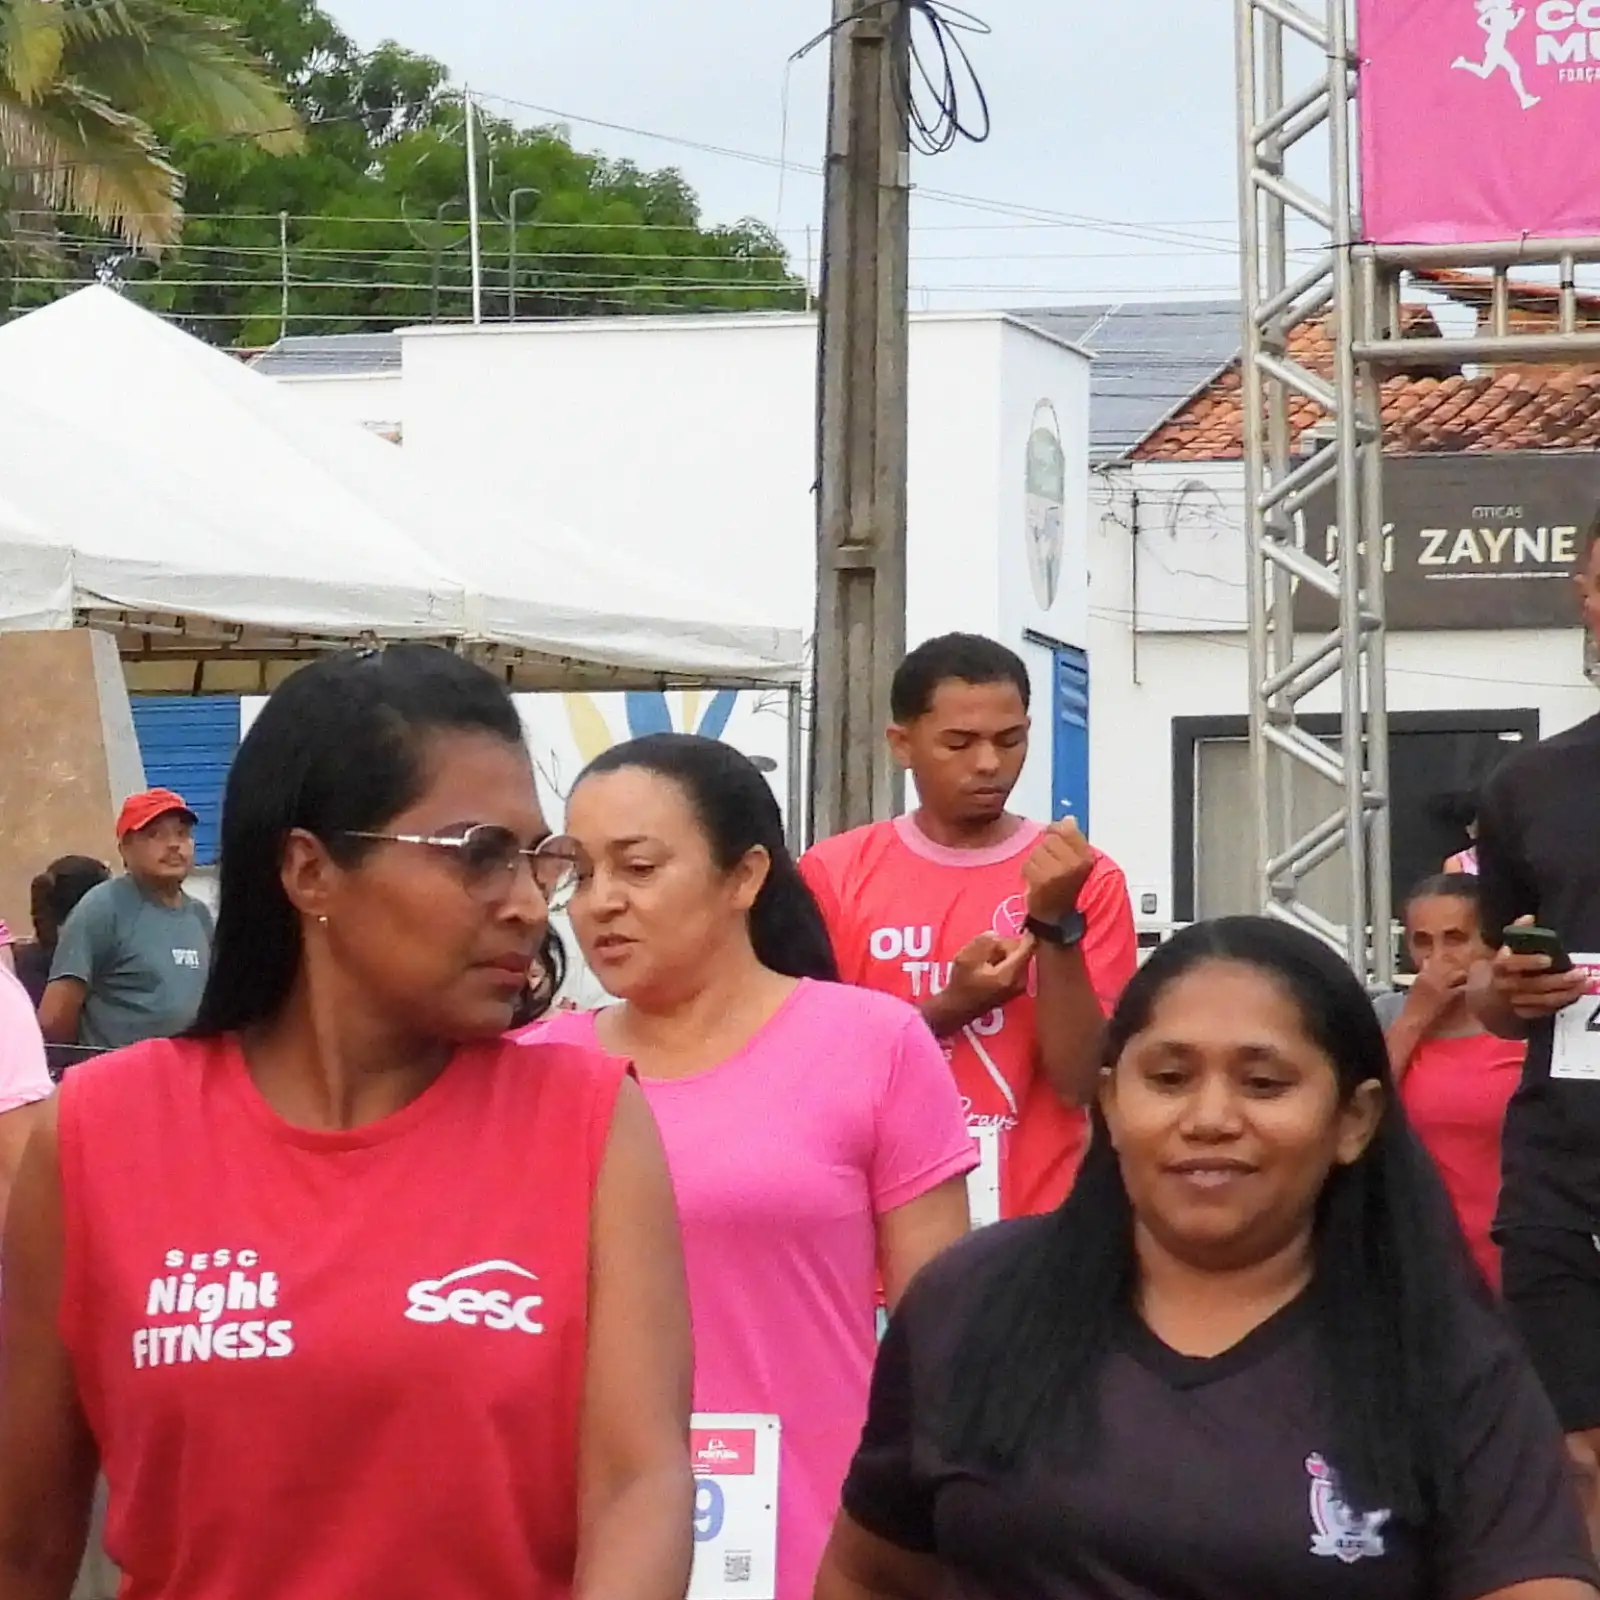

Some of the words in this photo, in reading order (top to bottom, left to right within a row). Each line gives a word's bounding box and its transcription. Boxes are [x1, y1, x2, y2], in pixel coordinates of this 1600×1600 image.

[1418, 526, 1578, 564] ZAYNE
[870, 925, 932, 960] OU
[164, 1248, 259, 1271] SESC
[146, 1271, 279, 1323] Night
[132, 1320, 294, 1369] FITNESS
